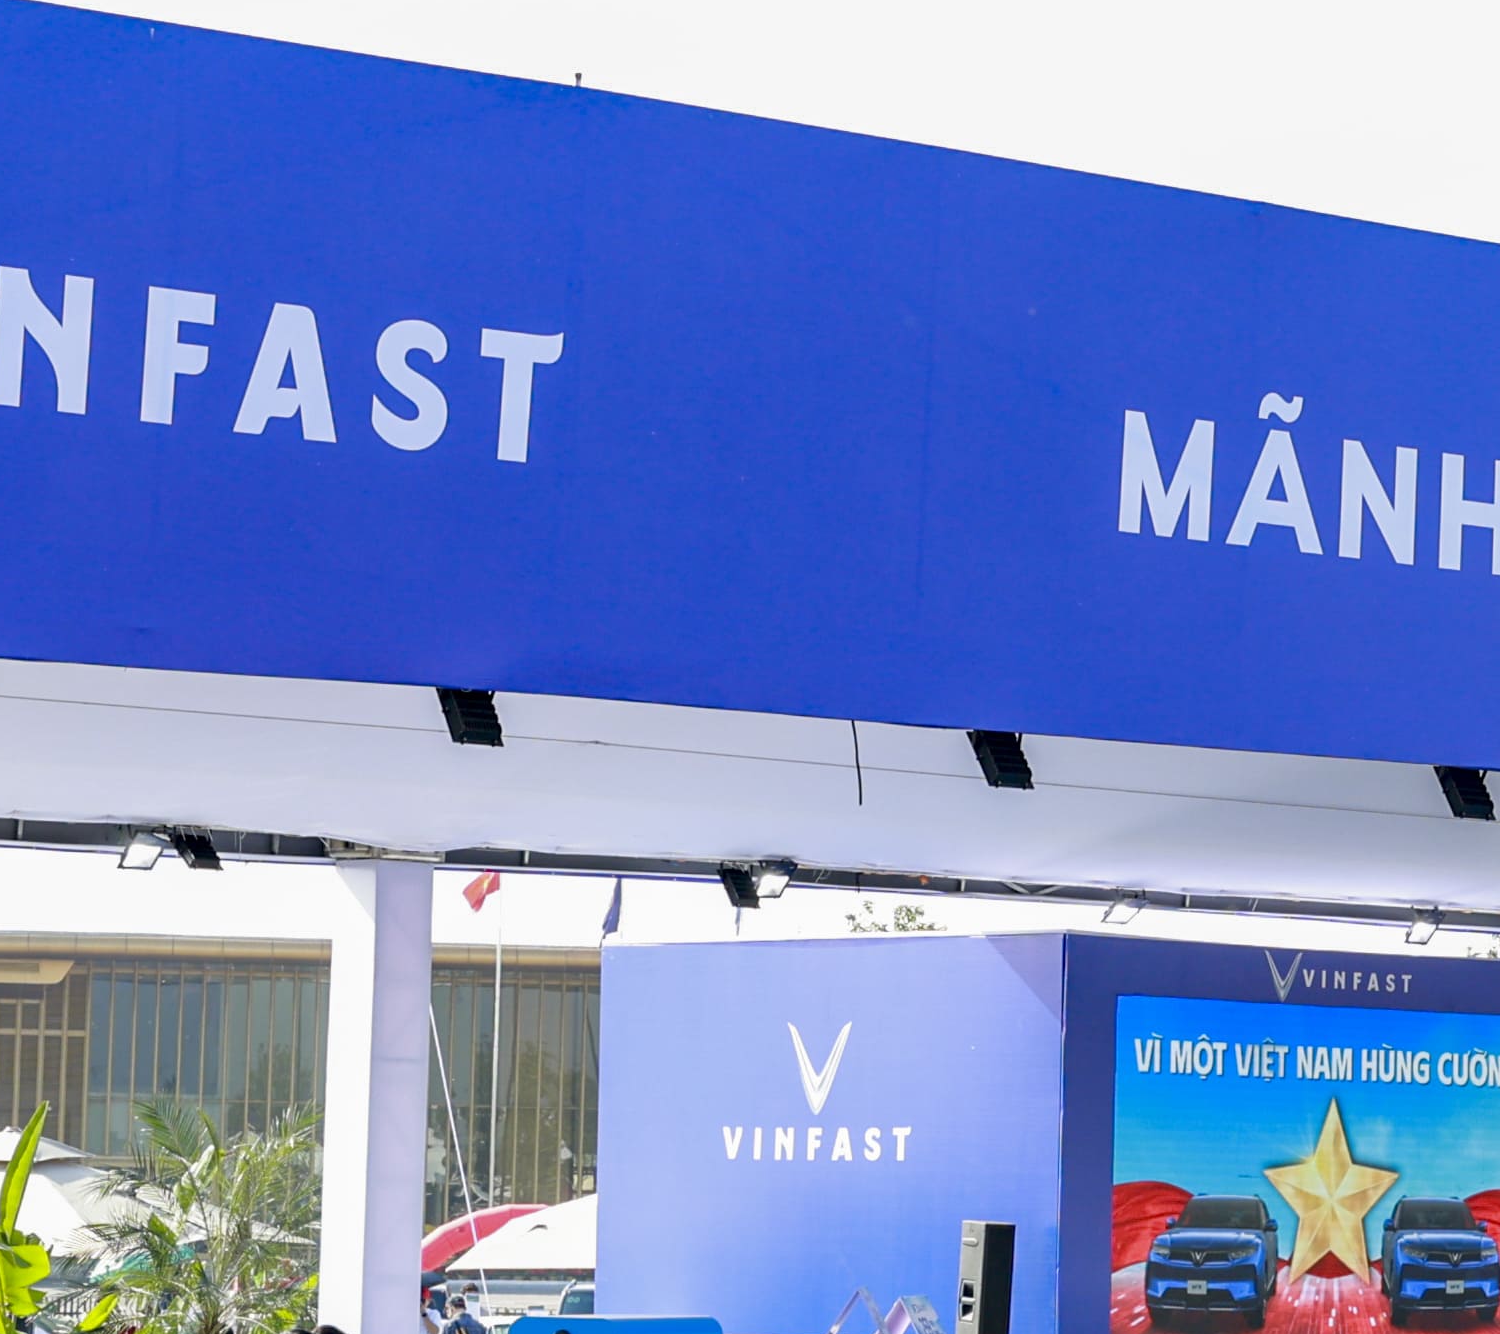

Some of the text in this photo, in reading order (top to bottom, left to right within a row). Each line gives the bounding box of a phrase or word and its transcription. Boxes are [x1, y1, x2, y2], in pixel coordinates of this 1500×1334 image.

[1303, 968, 1413, 994] VINFAST
[1134, 1032, 1164, 1074] VÌ
[1170, 1034, 1227, 1080] MỘT
[1235, 1037, 1289, 1083] VIỆT
[1297, 1046, 1353, 1082] NAM
[1361, 1043, 1431, 1085] HÙNG
[722, 1125, 912, 1163] VINFAST
